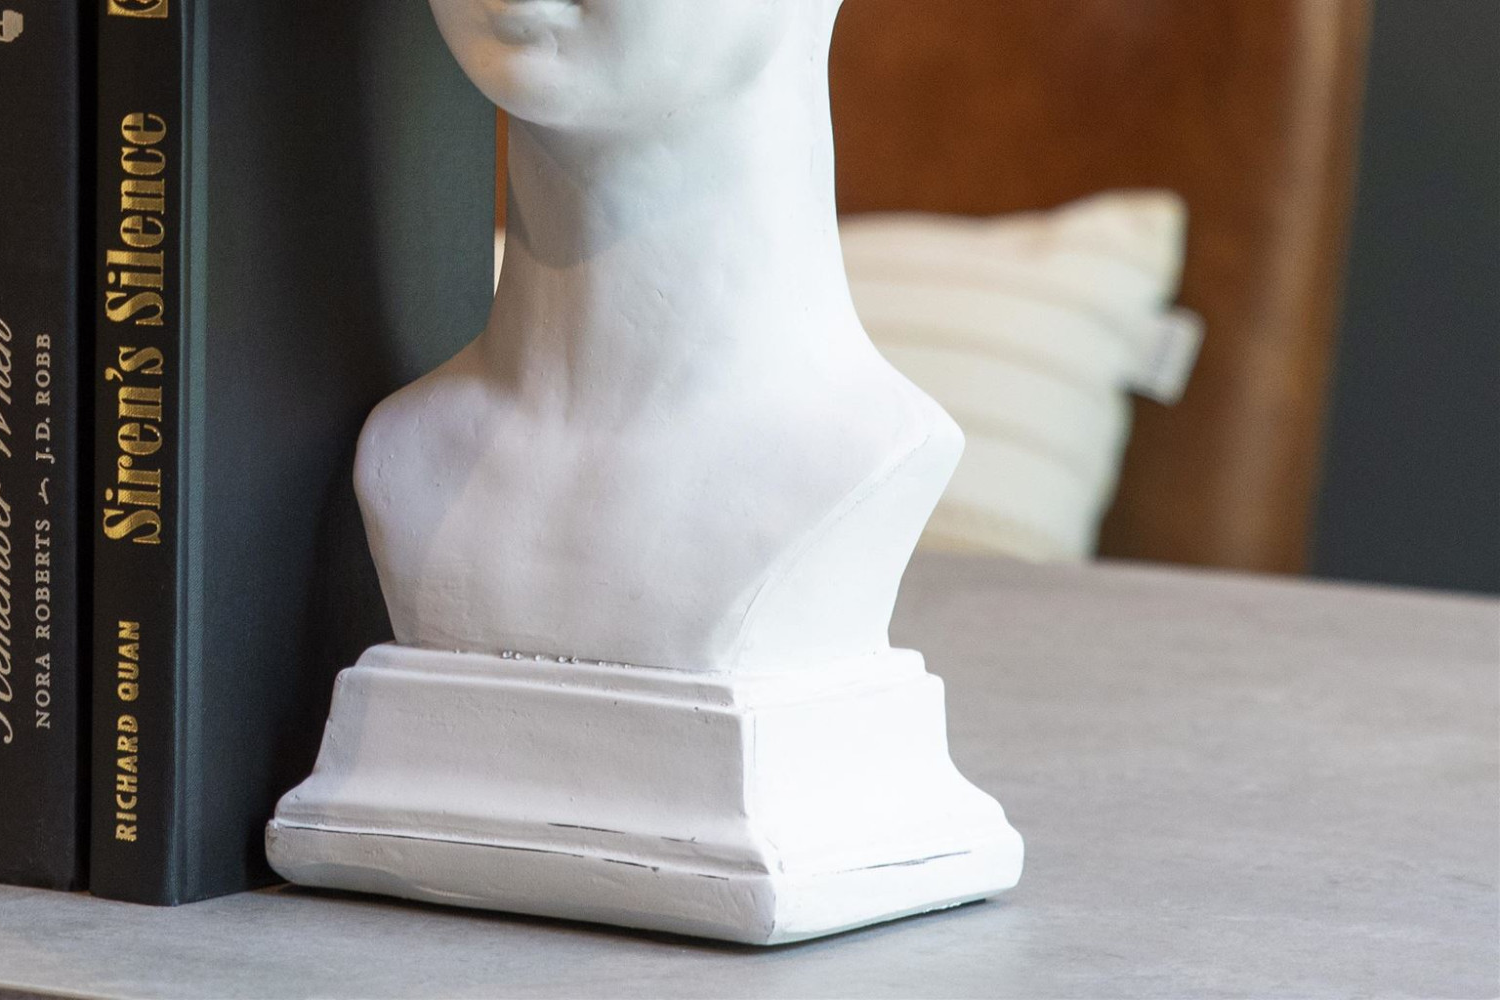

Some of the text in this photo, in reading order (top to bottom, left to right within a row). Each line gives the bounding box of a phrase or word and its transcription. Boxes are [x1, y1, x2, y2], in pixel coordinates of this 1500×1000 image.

[35, 333, 51, 407] ROBB
[102, 113, 167, 545] Siren's Silence
[34, 519, 51, 640] ROBERTS
[35, 652, 51, 729] NORA
[115, 620, 140, 842] RICHARD QUAN
